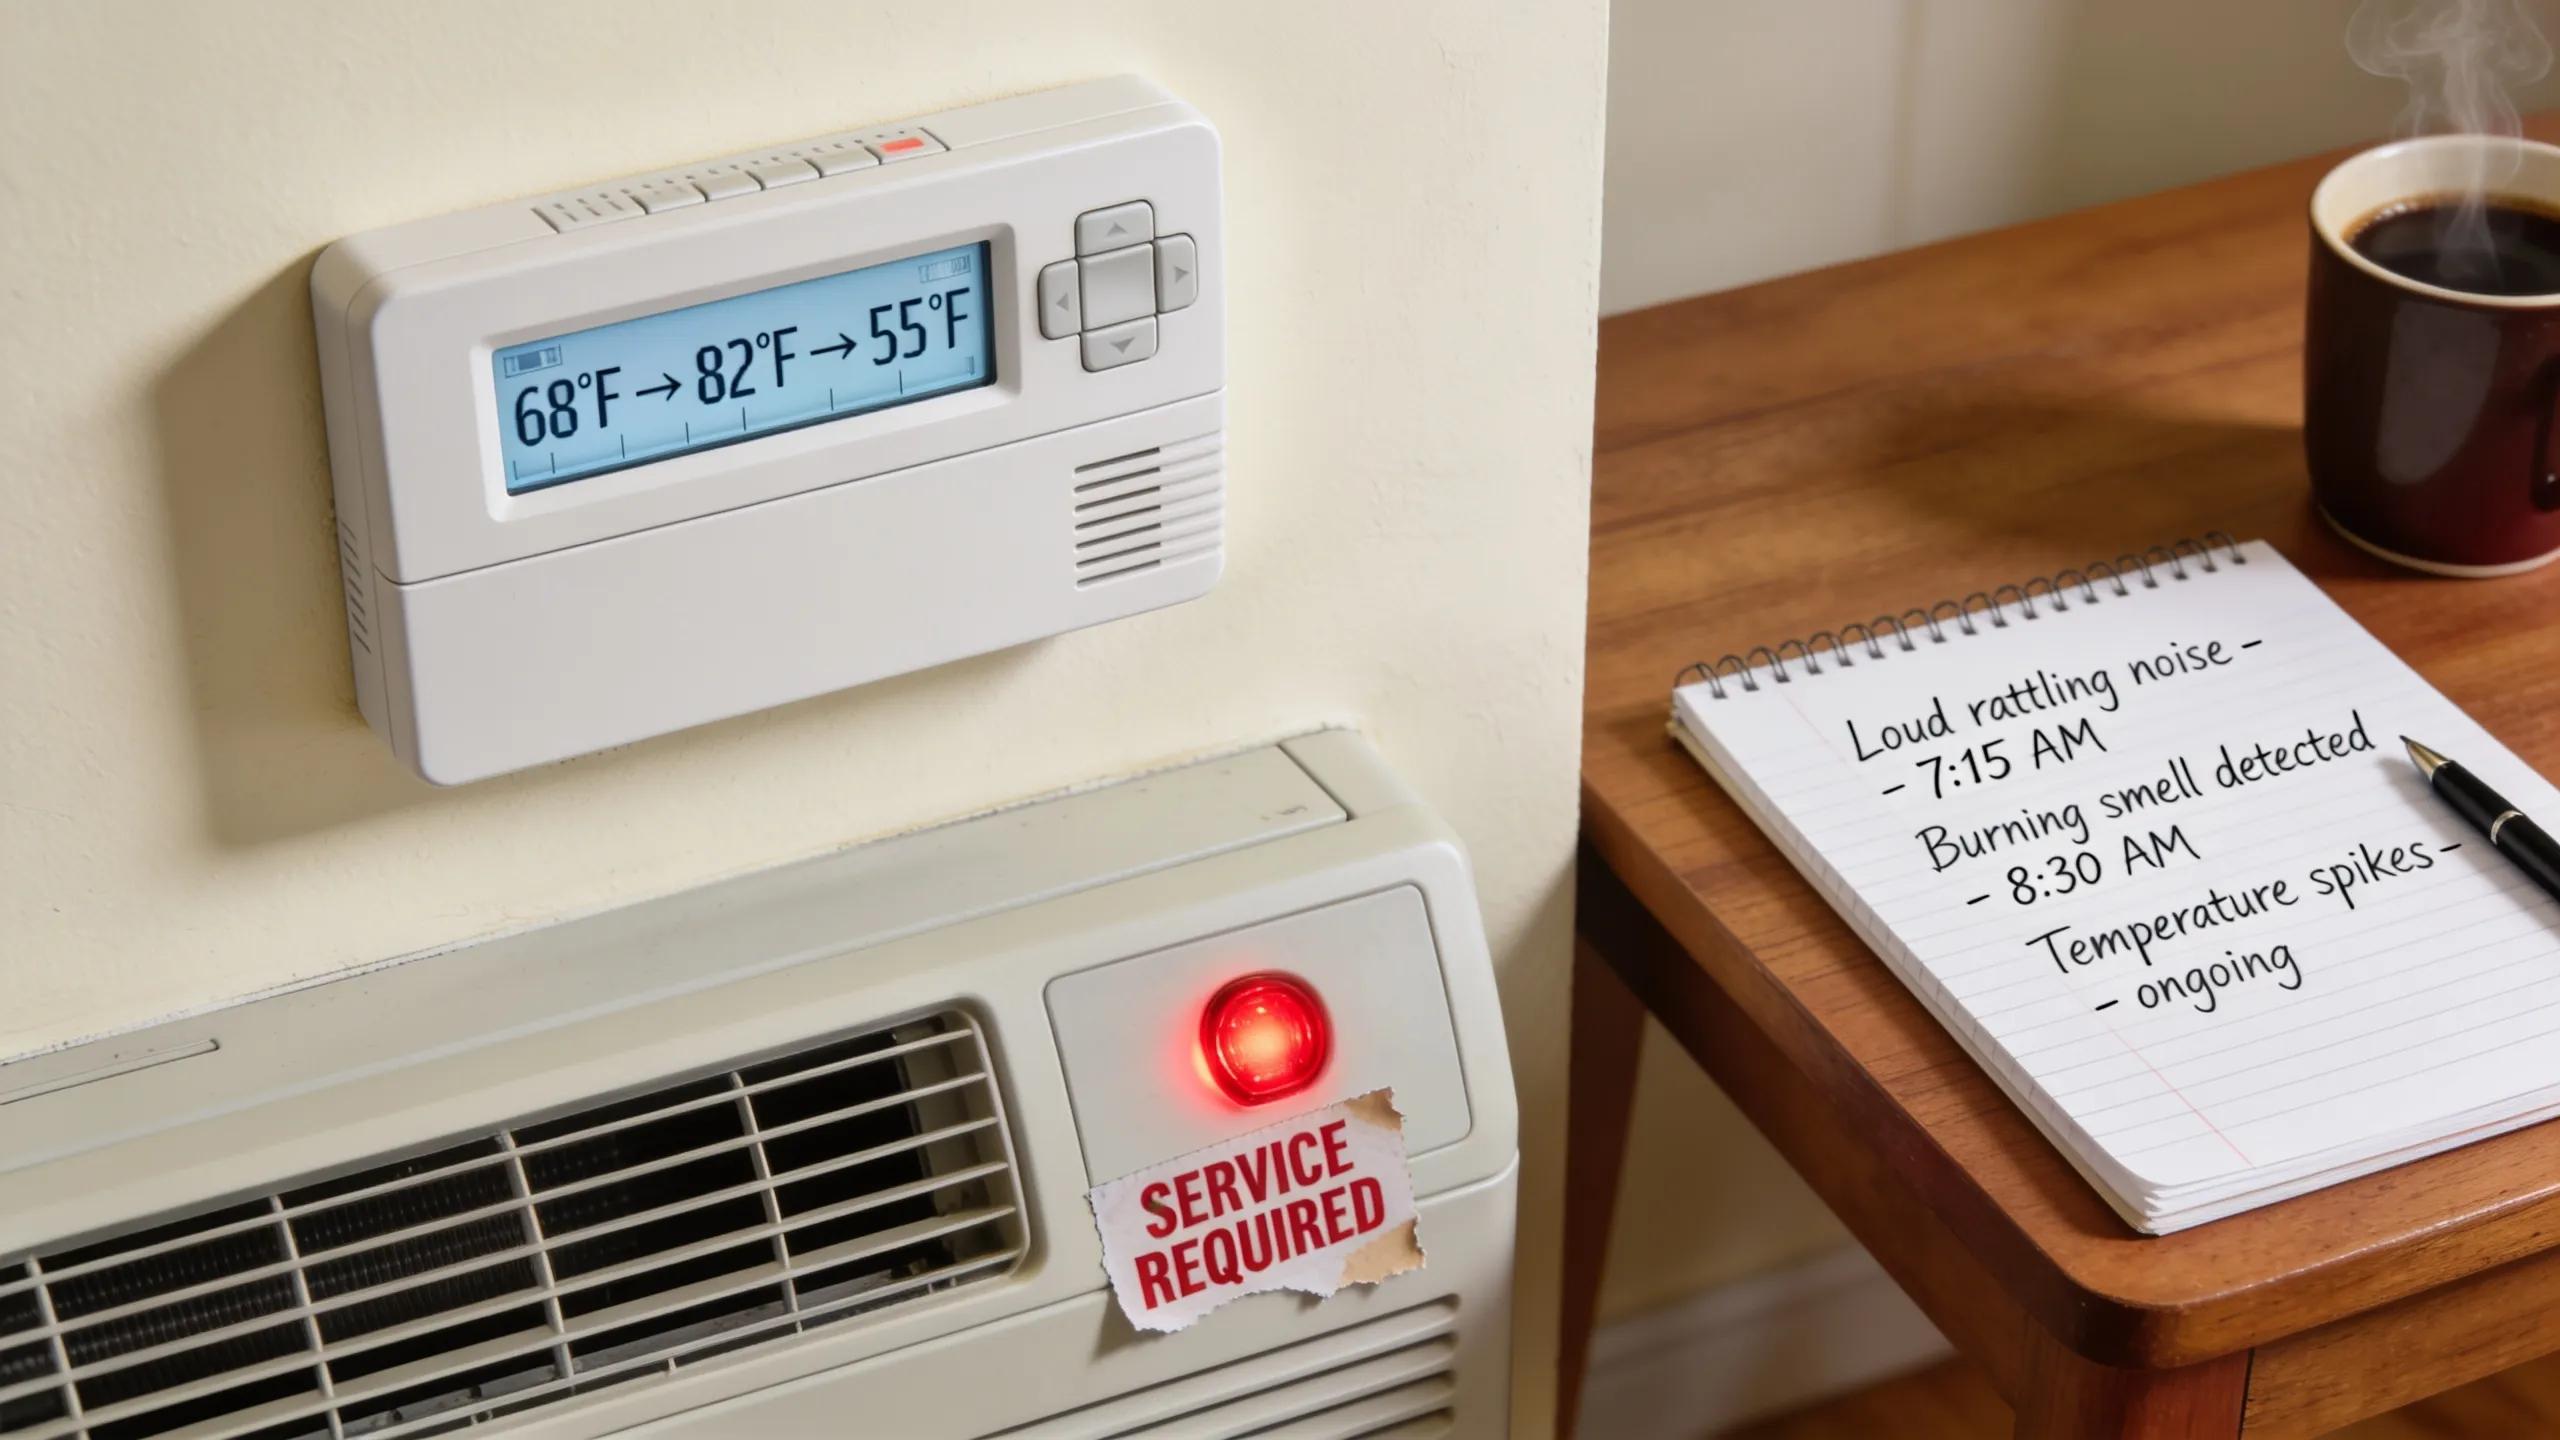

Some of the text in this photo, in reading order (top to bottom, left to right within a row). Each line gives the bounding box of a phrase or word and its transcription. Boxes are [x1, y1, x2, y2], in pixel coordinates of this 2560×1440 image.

[514, 287, 971, 447] 68°F 82°F 55°F
[1845, 696, 1956, 763] Loud
[1967, 667, 2120, 728] rattling
[2127, 640, 2234, 686] noise
[1914, 738, 2013, 801] 7:15
[2031, 716, 2108, 771] AM
[1914, 708, 2377, 874] Burning smell detected
[2005, 850, 2103, 907] 8:30
[2121, 823, 2202, 877] AM
[2024, 879, 2300, 975] Temperature
[2136, 944, 2303, 1014] ongoing
[1139, 1118, 1355, 1240] SERVICE
[1133, 1176, 1387, 1312] REQUIRED
